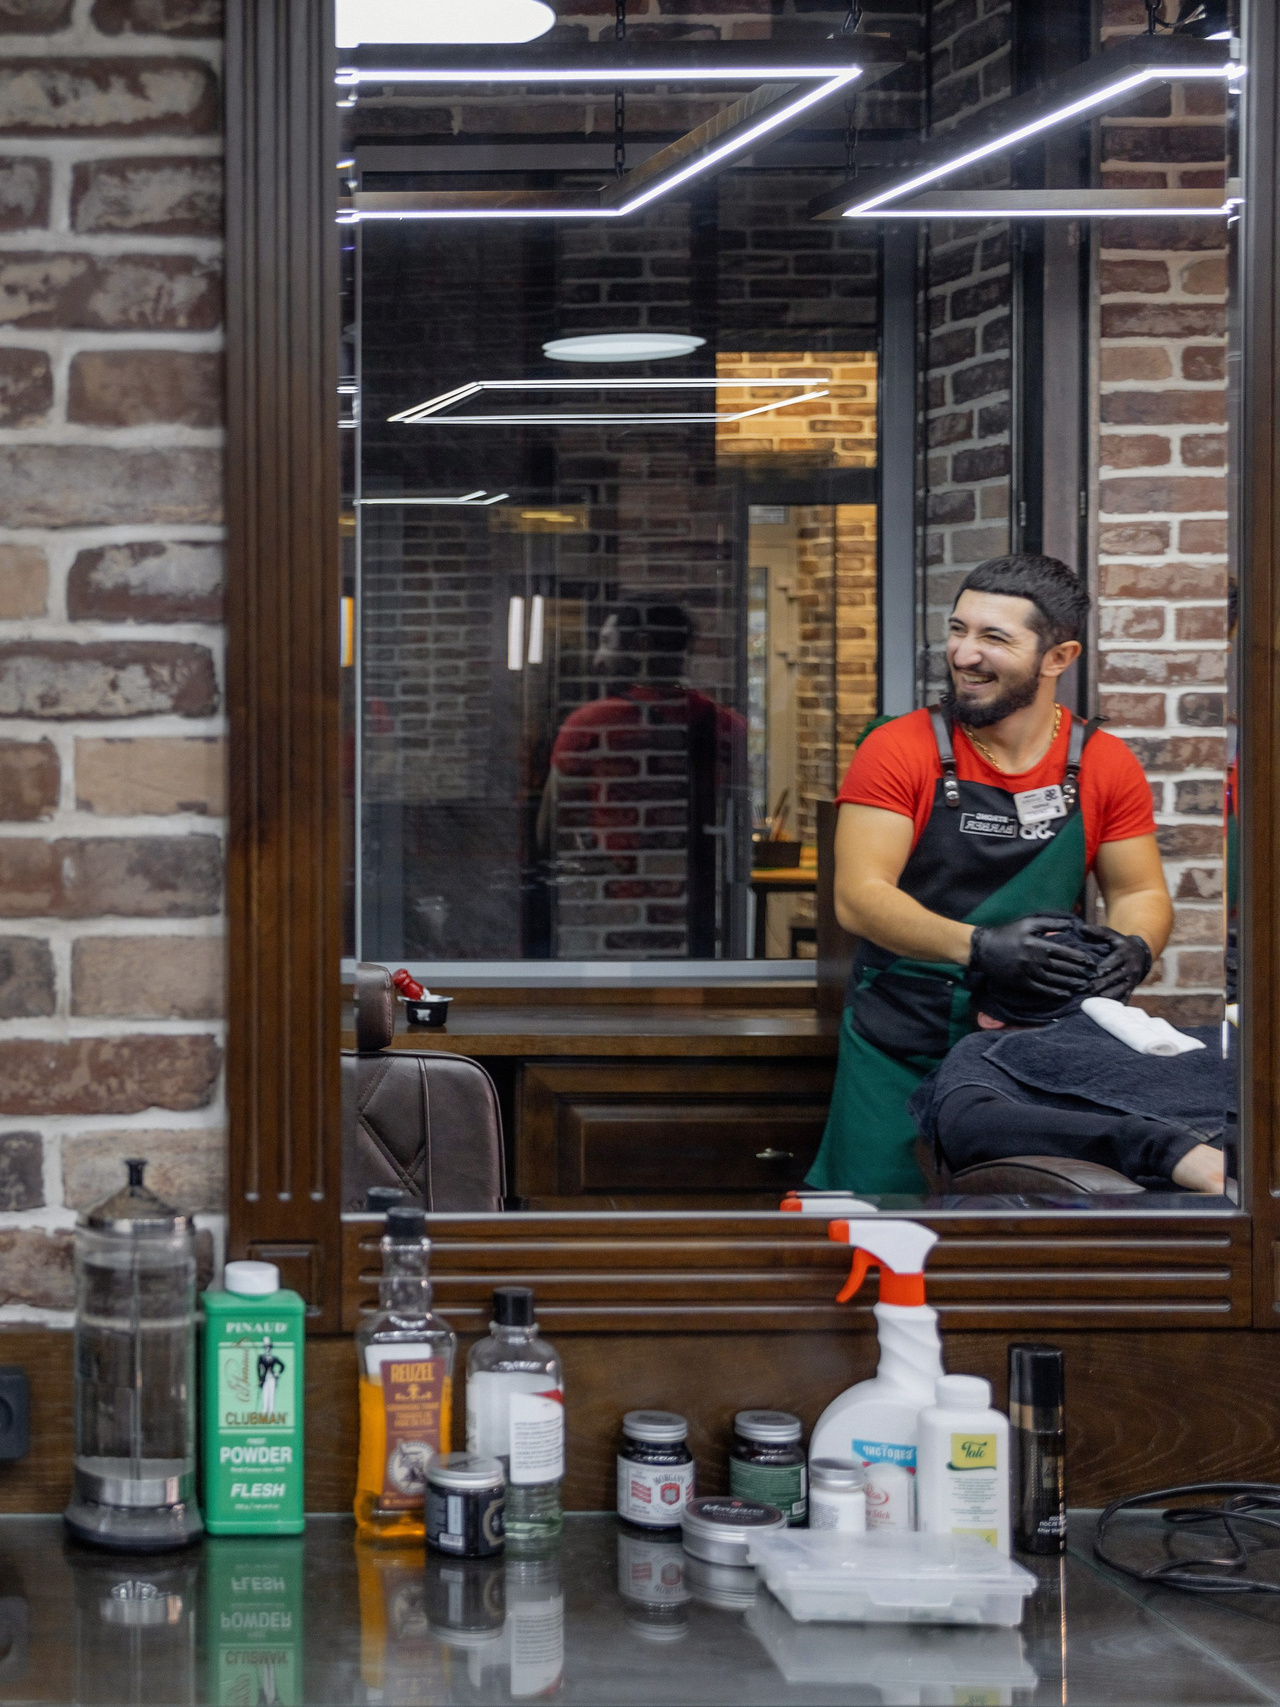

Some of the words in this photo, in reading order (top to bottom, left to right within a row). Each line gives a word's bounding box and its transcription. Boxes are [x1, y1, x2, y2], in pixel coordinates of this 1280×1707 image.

[226, 1322, 287, 1333] PINAUD
[390, 1362, 434, 1383] REUZEL
[225, 1411, 287, 1425] CLUBMAN
[220, 1446, 292, 1464] POWDER
[230, 1483, 286, 1497] FLESH
